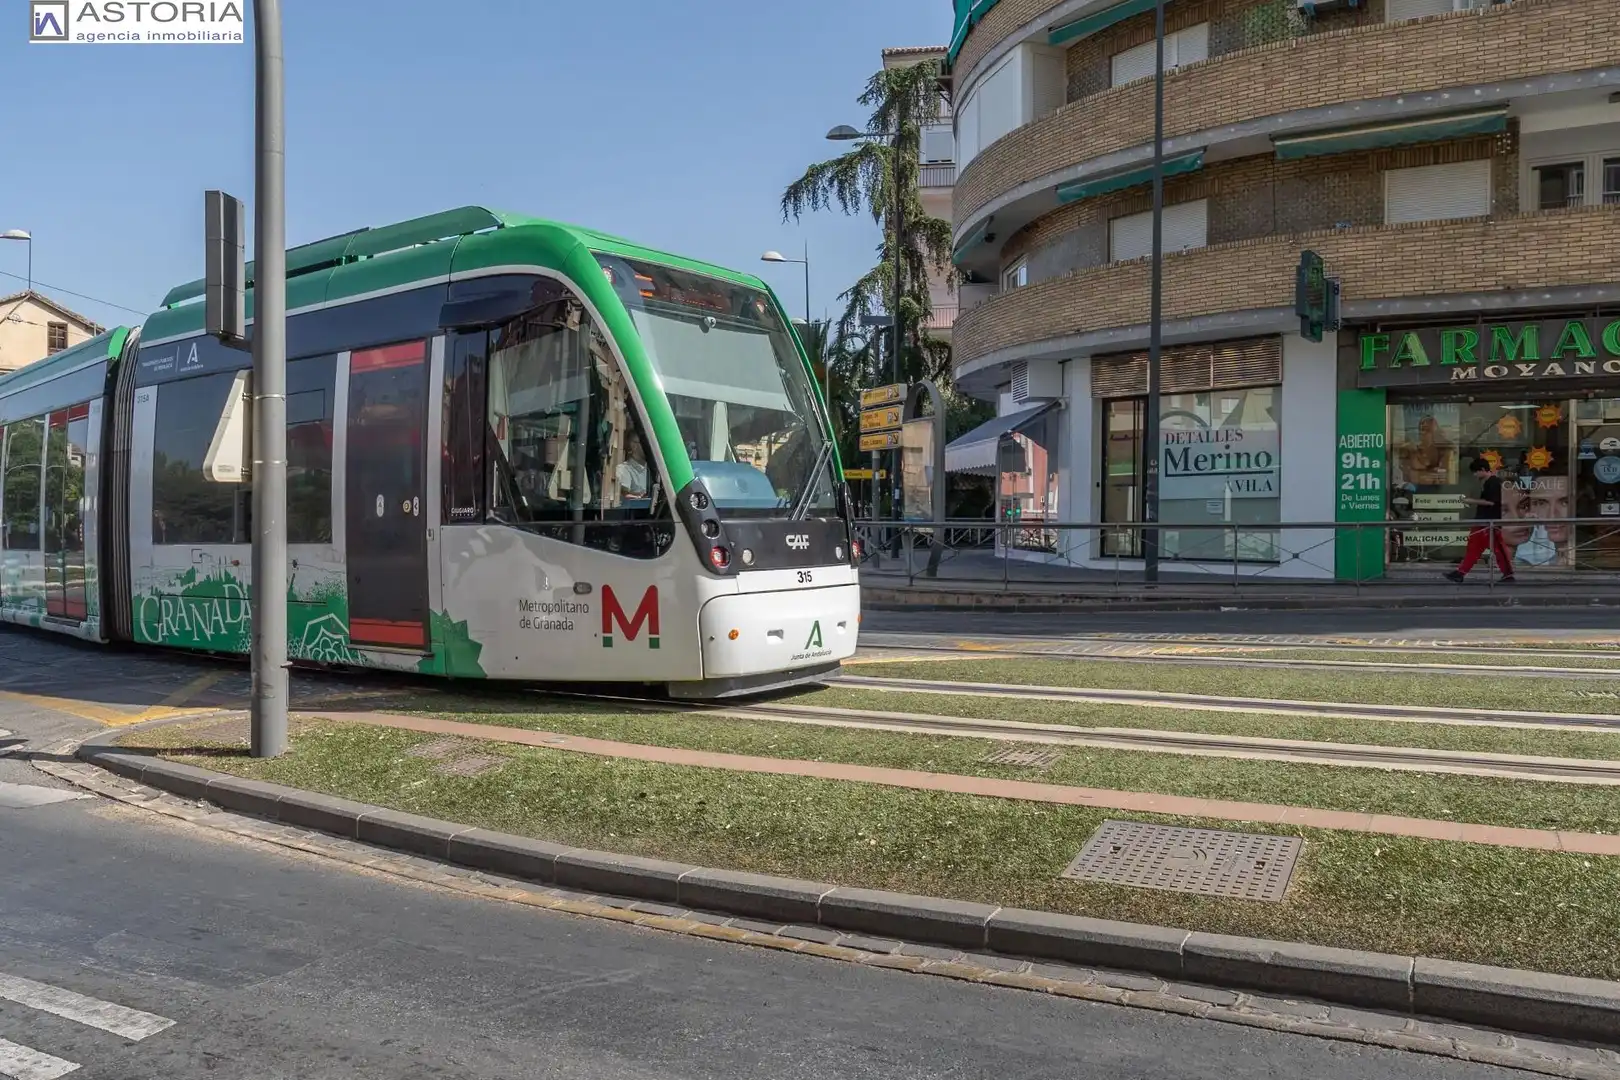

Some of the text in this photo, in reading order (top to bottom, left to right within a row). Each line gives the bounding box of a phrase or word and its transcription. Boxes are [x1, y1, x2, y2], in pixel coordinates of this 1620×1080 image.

[1450, 360, 1620, 380] MOYANO
[1165, 428, 1243, 445] DETALLES
[1339, 433, 1384, 449] ABIERTO
[1164, 444, 1273, 474] Merino
[1341, 452, 1380, 469] 9h a
[1341, 473, 1380, 490] 21h
[1341, 493, 1380, 502] De Lunes
[1348, 502, 1380, 510] Viernes
[785, 534, 810, 550] CAF
[797, 570, 813, 584] 315
[140, 583, 252, 643] GRANADA
[518, 599, 590, 615] Metropolitano
[519, 616, 574, 631] de Granada
[790, 653, 804, 661] Junta
